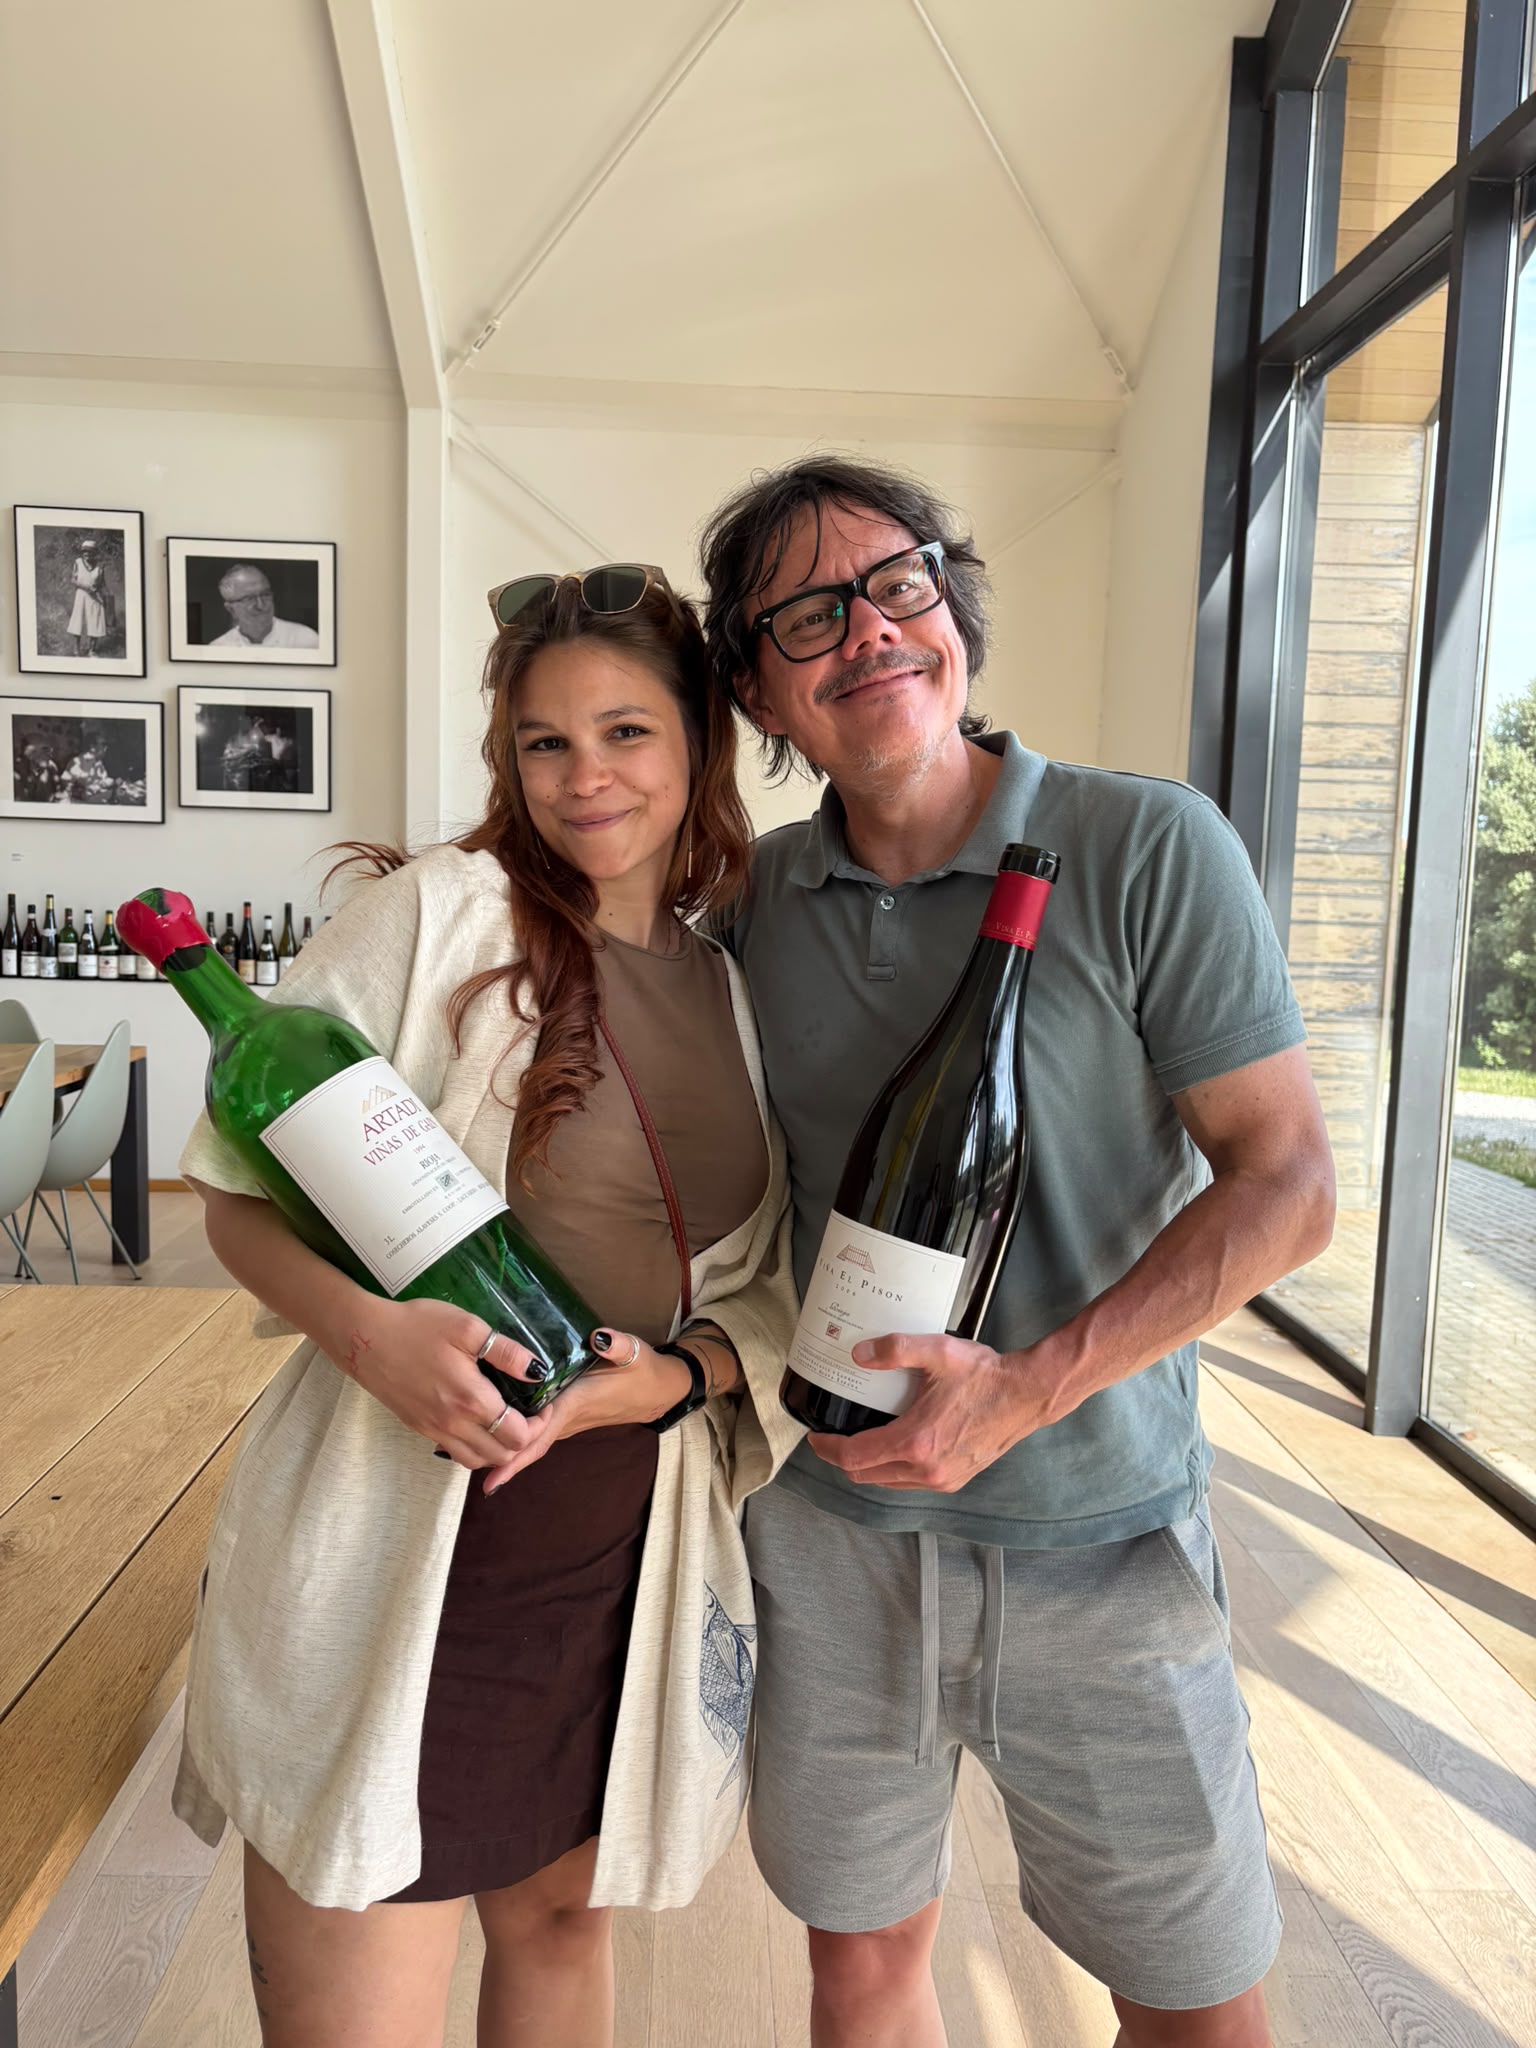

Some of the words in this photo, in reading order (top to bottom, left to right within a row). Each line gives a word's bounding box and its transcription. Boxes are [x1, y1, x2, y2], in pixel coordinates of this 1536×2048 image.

[363, 1098, 421, 1142] ARTADI
[363, 1135, 403, 1165] VIÑAS
[401, 1125, 421, 1141] DE
[419, 1153, 441, 1170] RIOJA
[386, 1233, 416, 1259] COSECHEROS
[416, 1215, 439, 1235] ALAVESES
[840, 1270, 853, 1284] EL
[861, 1279, 904, 1302] PISON
